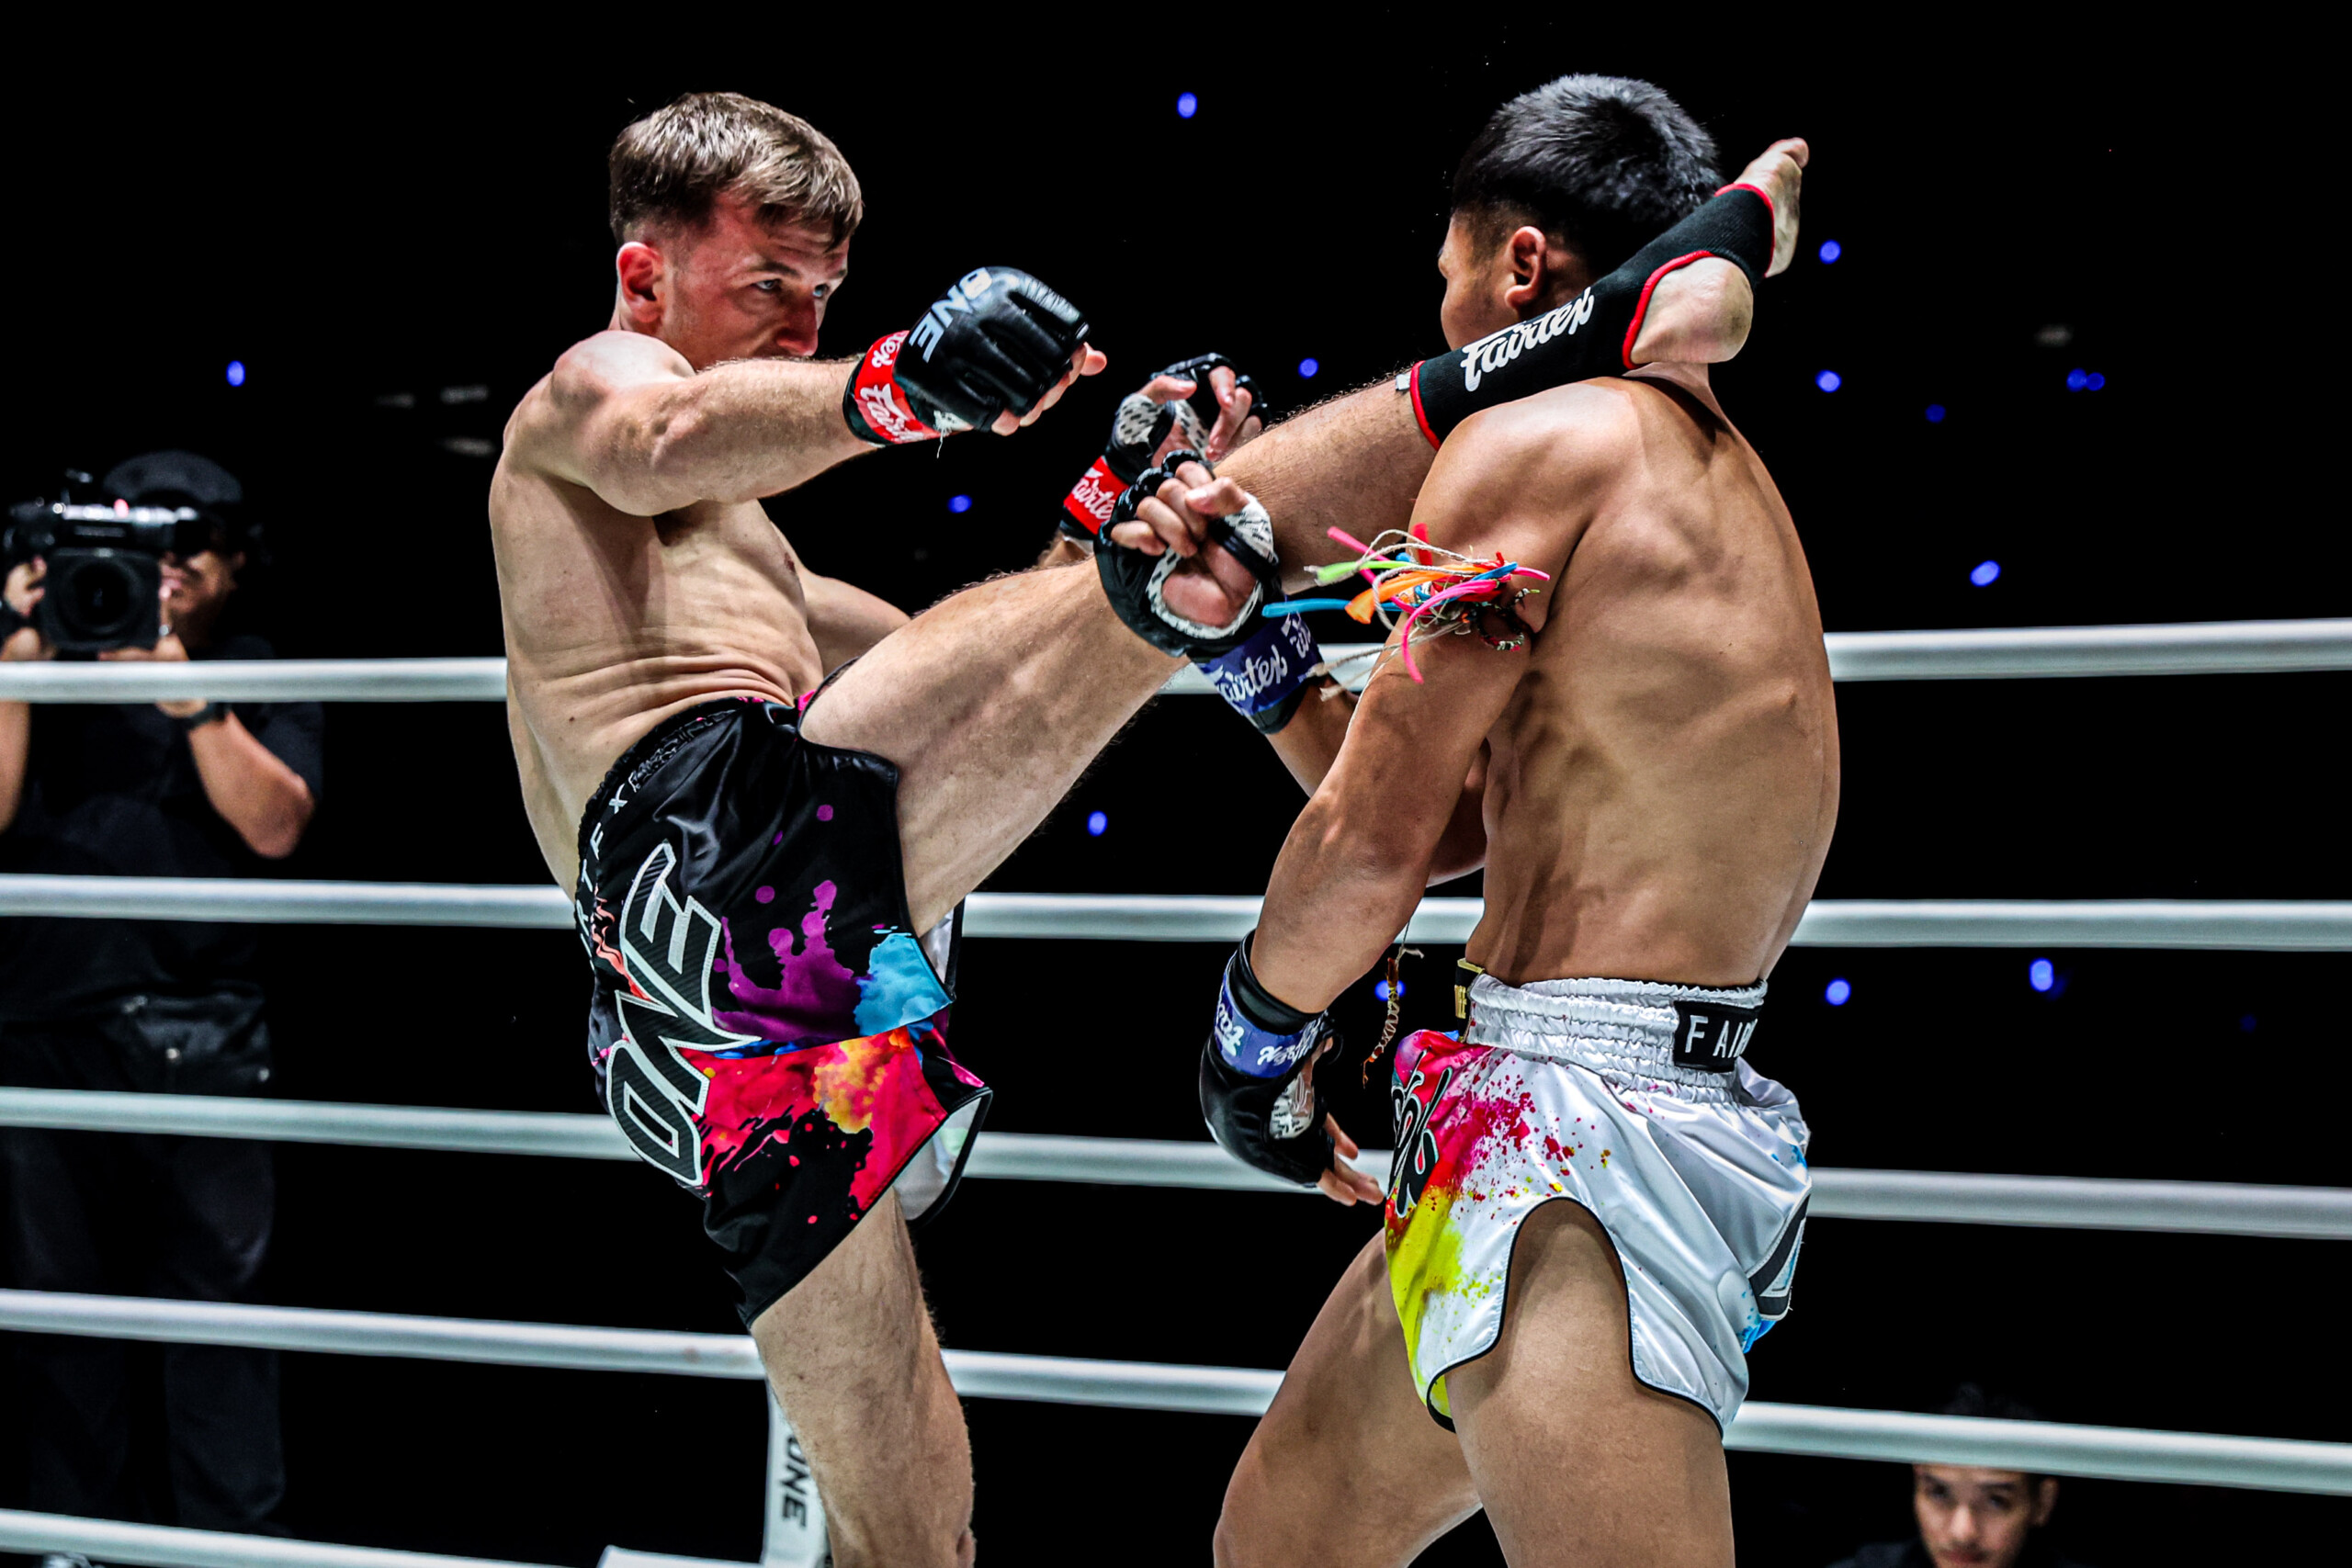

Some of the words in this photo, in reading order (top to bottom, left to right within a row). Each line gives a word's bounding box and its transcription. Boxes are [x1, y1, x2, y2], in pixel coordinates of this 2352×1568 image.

[909, 267, 993, 364] ONE
[1460, 286, 1596, 392] Fairtex
[606, 837, 763, 1187] ONE
